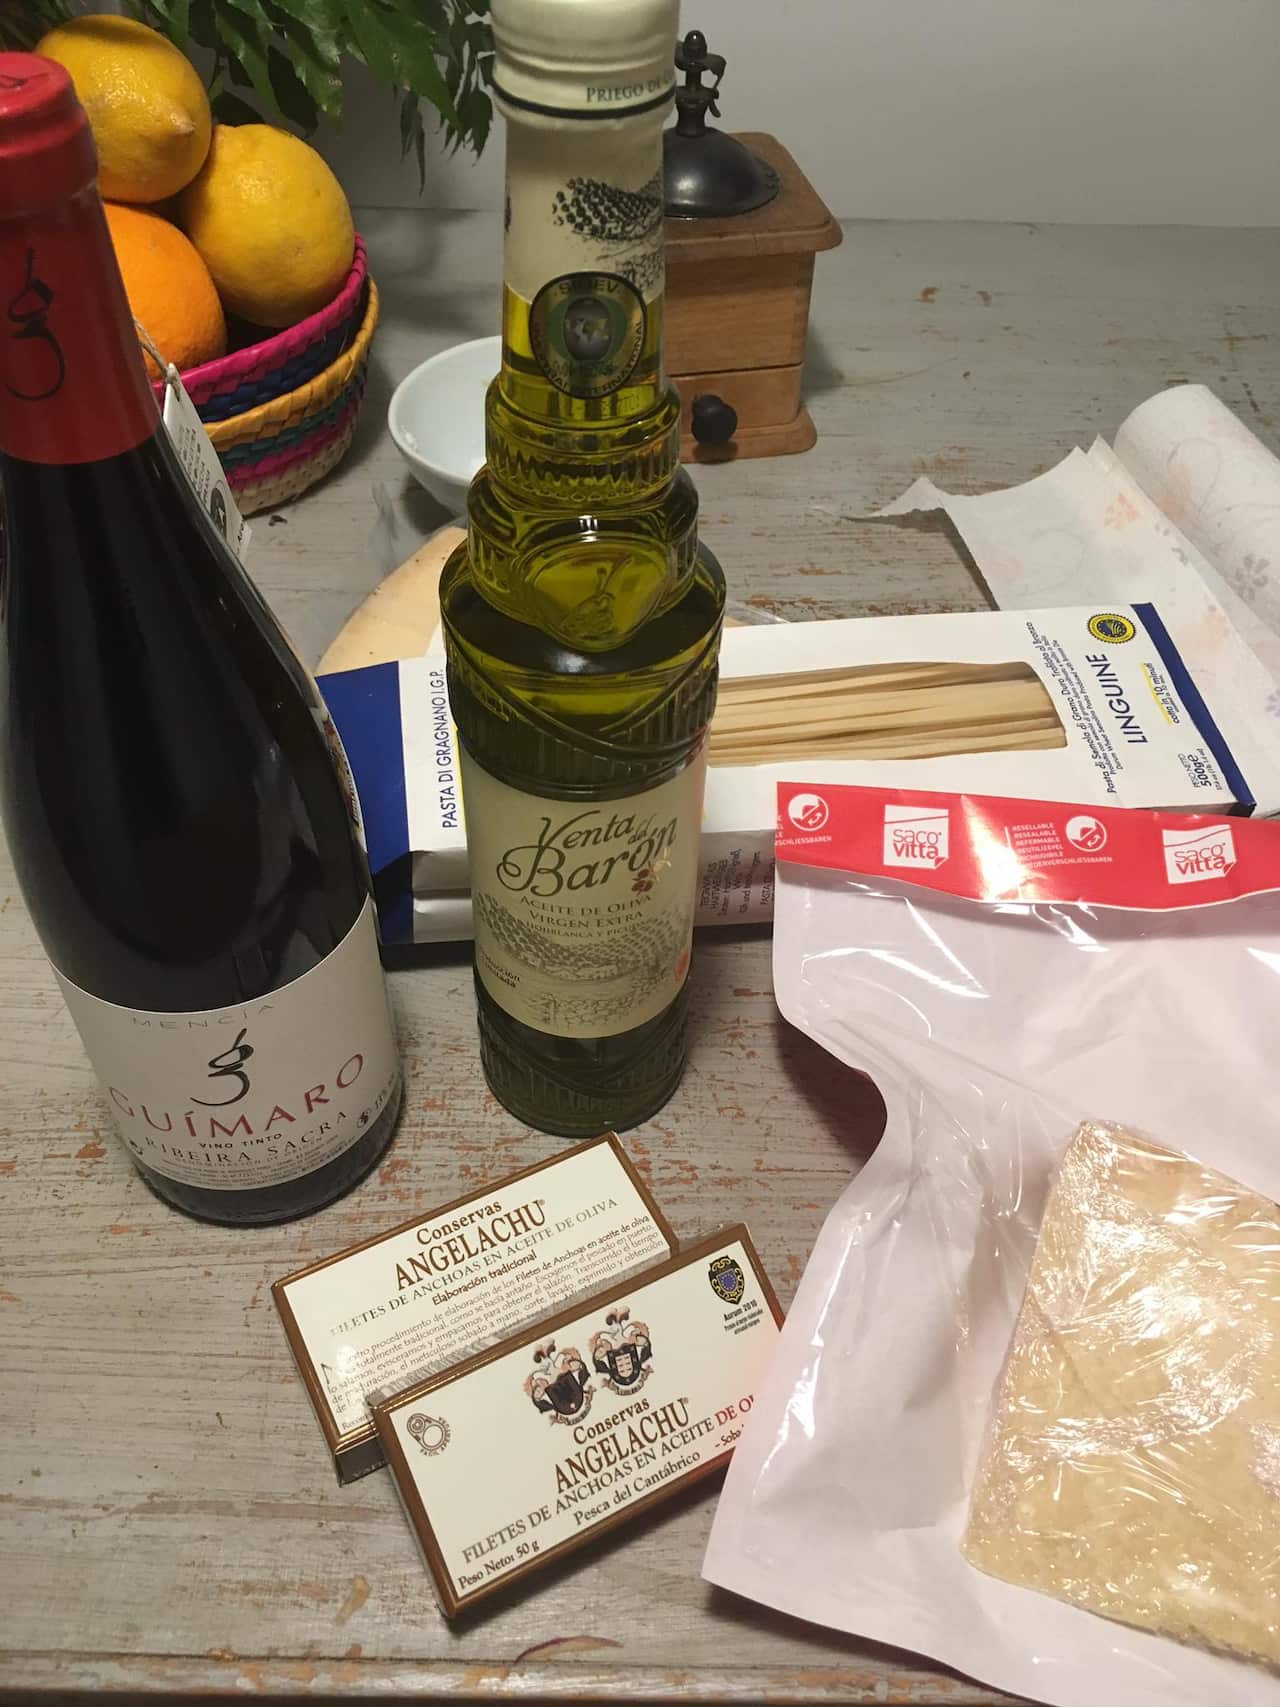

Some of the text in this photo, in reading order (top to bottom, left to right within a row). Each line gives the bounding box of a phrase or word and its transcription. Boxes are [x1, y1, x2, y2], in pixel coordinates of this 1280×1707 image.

[587, 83, 645, 103] PRIEGO
[1058, 678, 1071, 696] Duro
[1086, 653, 1148, 744] LINGUINE
[1153, 685, 1166, 696] 10
[1067, 697, 1082, 721] Grano
[1076, 719, 1087, 730] di
[430, 669, 458, 829] PASTA DI GRAGNANO I.G.P.
[1082, 732, 1101, 760] Semola
[1094, 758, 1106, 769] di
[1102, 771, 1116, 793] Pasta
[541, 810, 636, 849] Venta
[893, 828, 938, 845] saco
[496, 818, 678, 897] Barón
[893, 842, 939, 860] vitta
[1174, 844, 1223, 863] saco
[1176, 855, 1225, 875] vitta
[521, 895, 652, 916] ACEITE DE OLIVA
[529, 910, 643, 929] VIRGEN EXTRA
[132, 1003, 275, 1030] MENCÍA
[109, 1053, 364, 1139] GUÍMARO
[145, 1136, 252, 1163] RIBEIRA
[267, 1111, 347, 1154] SACRA
[200, 1132, 283, 1150] VINO TINTO
[416, 1199, 502, 1246] Conservas
[388, 1294, 409, 1310] DE
[413, 1261, 481, 1300] ANCHOAS
[482, 1250, 502, 1266] EN
[507, 1228, 554, 1256] ACEITE
[555, 1217, 575, 1233] DE
[576, 1199, 618, 1222] OLIVA
[371, 1320, 432, 1352] procedimiento
[433, 1313, 443, 1322] de
[515, 1267, 541, 1283] Filetes
[542, 1262, 552, 1270] de
[553, 1246, 586, 1266] Anchoas
[586, 1241, 598, 1249] en
[598, 1230, 620, 1244] aceite
[620, 1224, 631, 1233] de
[631, 1216, 650, 1228] oliva
[432, 1249, 537, 1306] Elaboración tradicional
[573, 1397, 650, 1445] Conservas
[462, 1520, 526, 1563] FILETES
[528, 1505, 552, 1528] DE
[556, 1461, 632, 1514] ANCHOAS
[634, 1448, 656, 1469] EN
[662, 1417, 714, 1456] ACEITE
[714, 1405, 738, 1426] DE
[573, 1452, 700, 1526] Pesca del Cantábrico
[458, 1571, 484, 1590] Peso
[516, 1542, 530, 1558] 50
[531, 1540, 540, 1552] g
